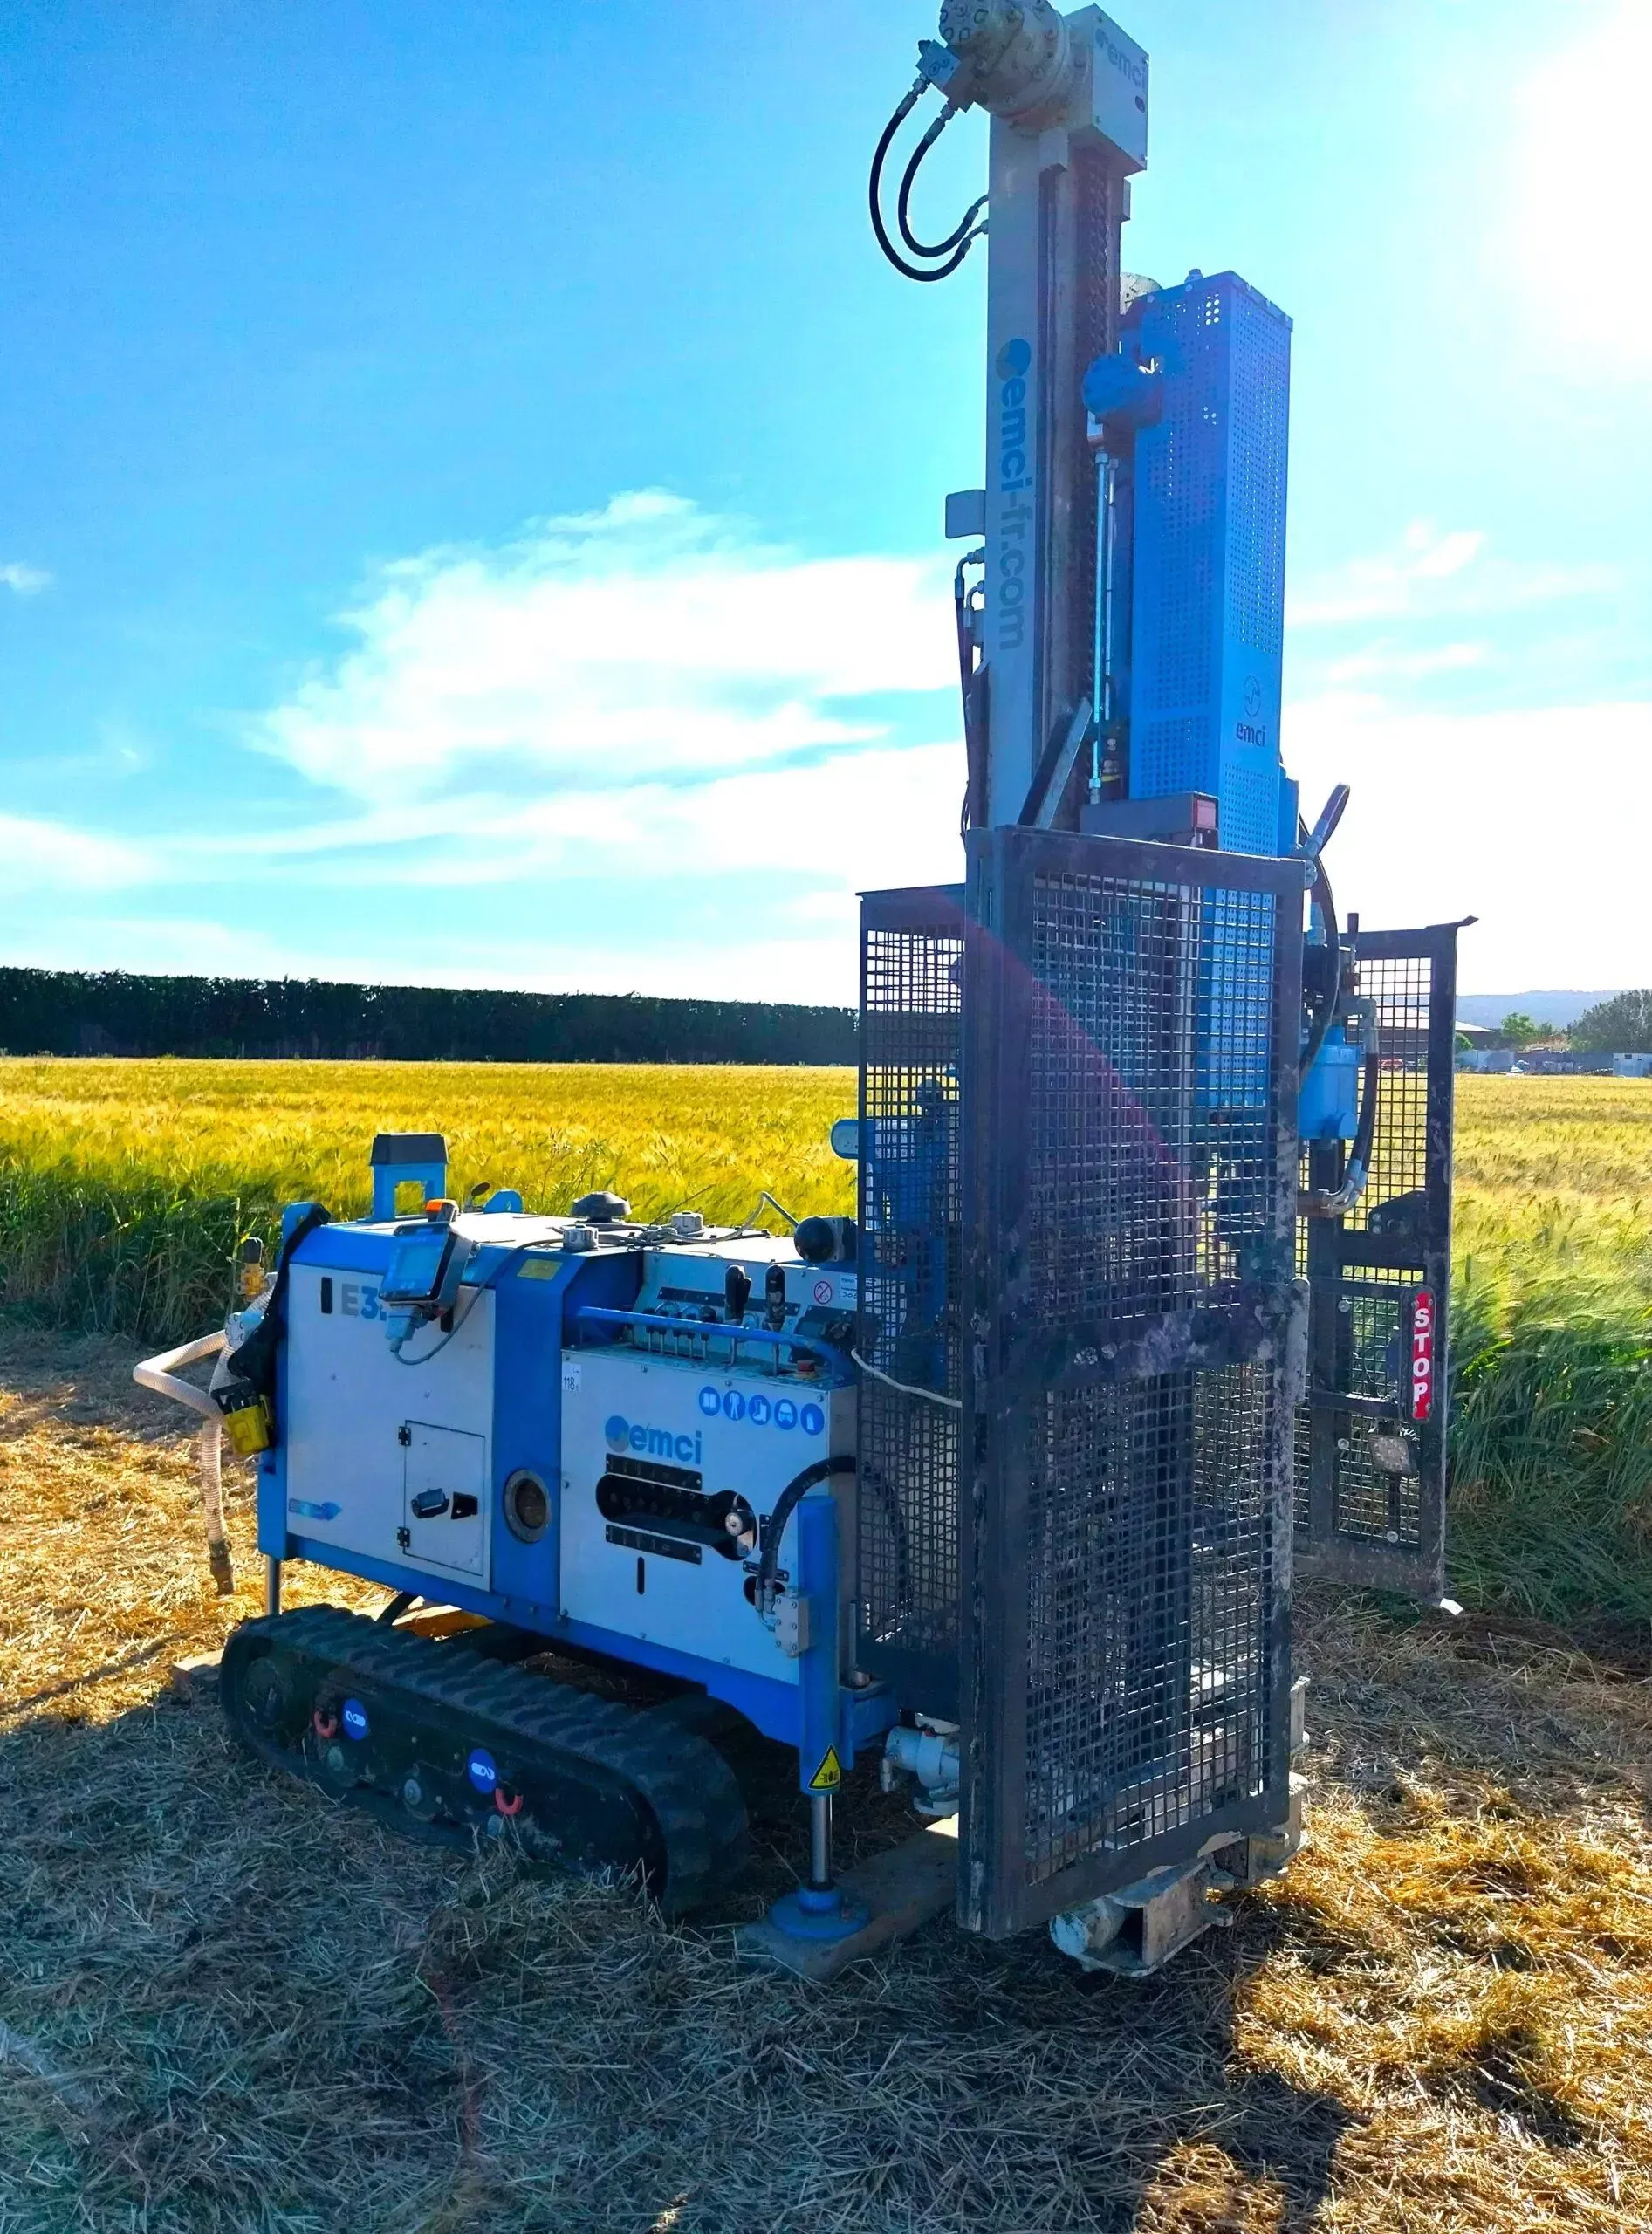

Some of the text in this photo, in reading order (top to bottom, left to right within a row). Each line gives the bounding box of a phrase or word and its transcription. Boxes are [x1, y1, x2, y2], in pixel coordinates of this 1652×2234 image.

[1107, 43, 1147, 93] emci
[998, 377, 1033, 651] emci-fr.com
[1236, 722, 1265, 748] emci
[1412, 1307, 1430, 1402] STOP
[628, 1424, 702, 1465] emci
